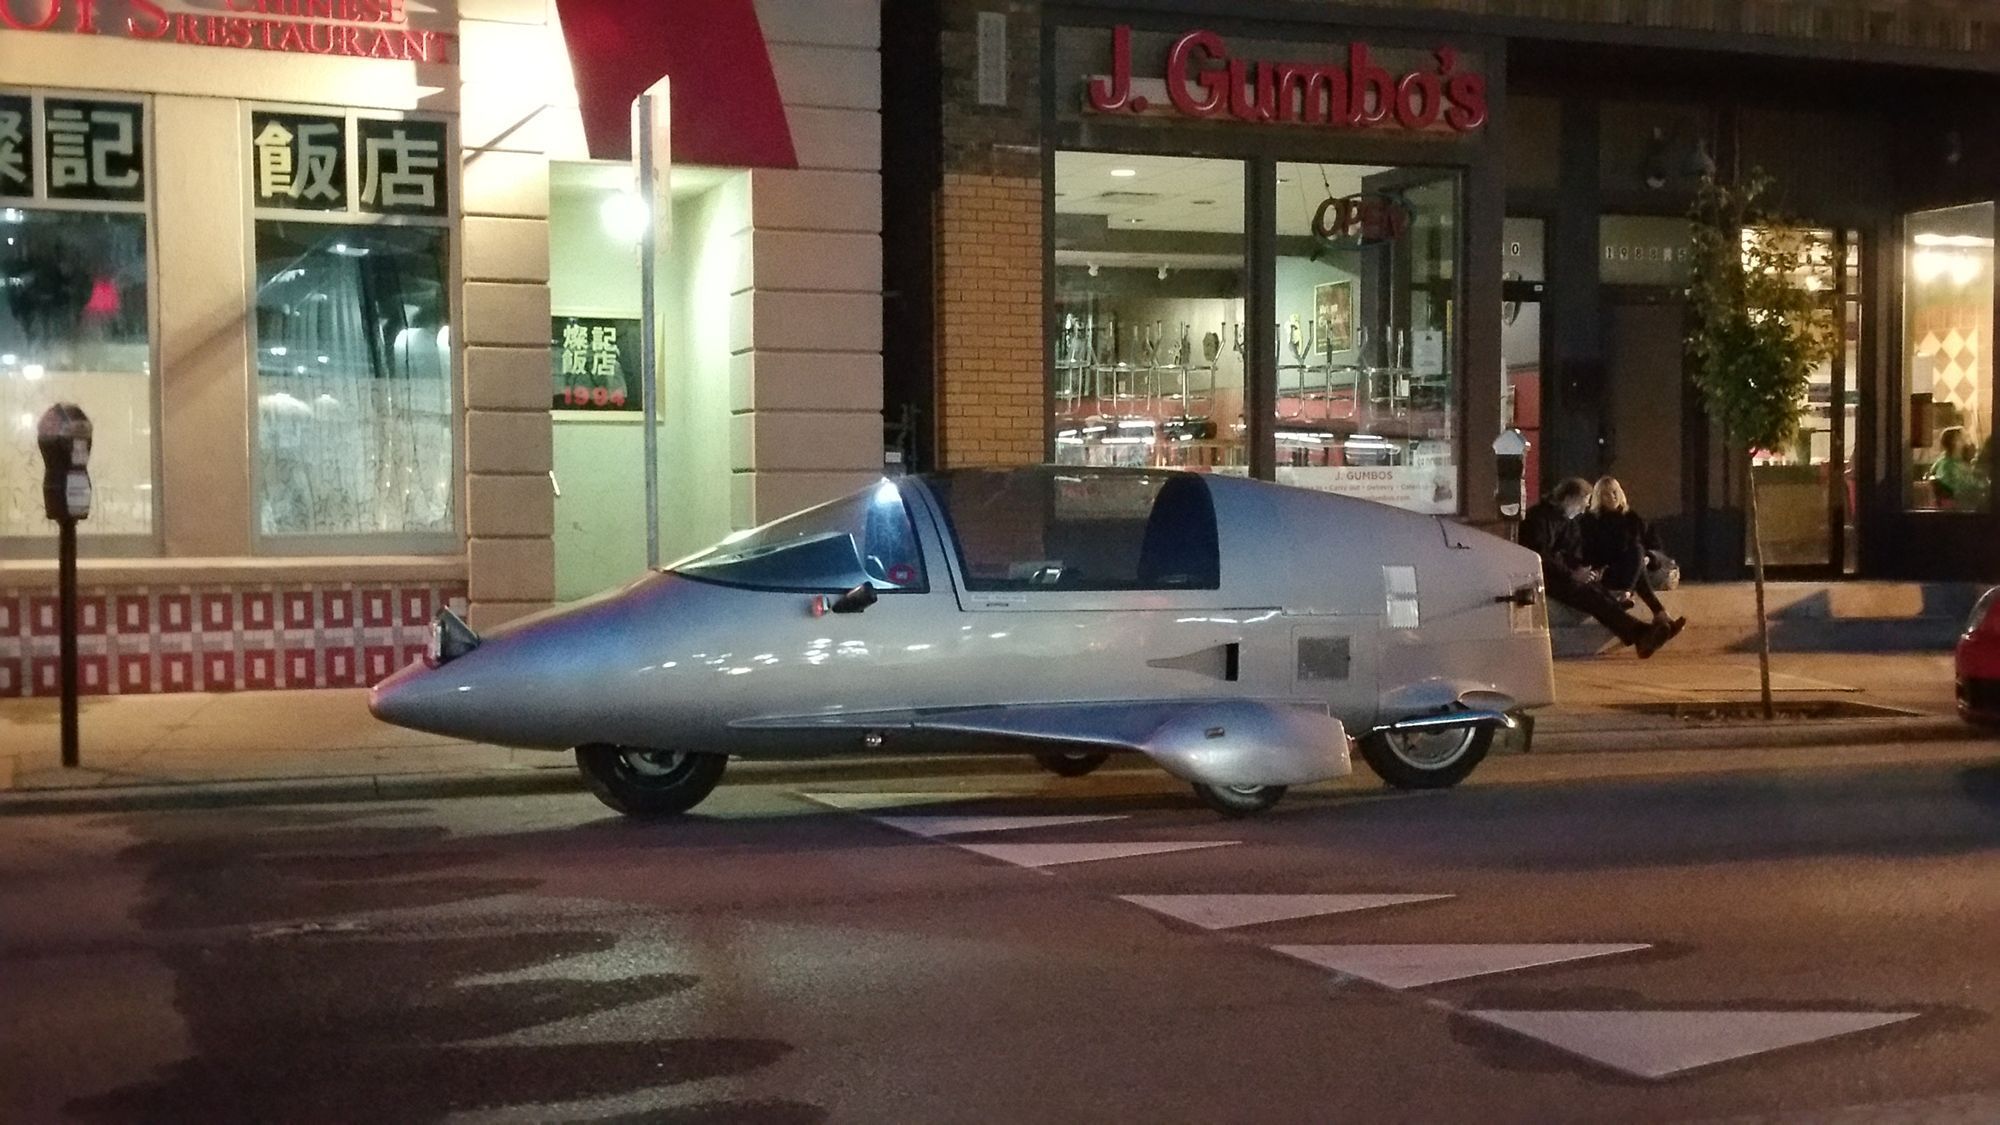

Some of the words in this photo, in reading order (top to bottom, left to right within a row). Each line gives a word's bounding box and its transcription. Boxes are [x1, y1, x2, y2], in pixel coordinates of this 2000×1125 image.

[223, 0, 410, 25] HINESE
[175, 14, 458, 64] RESTAURANT
[1088, 23, 1148, 113] J.
[1166, 29, 1489, 132] Gumbo's
[254, 119, 439, 207] 飯店
[1346, 470, 1393, 481] GUMBOS
